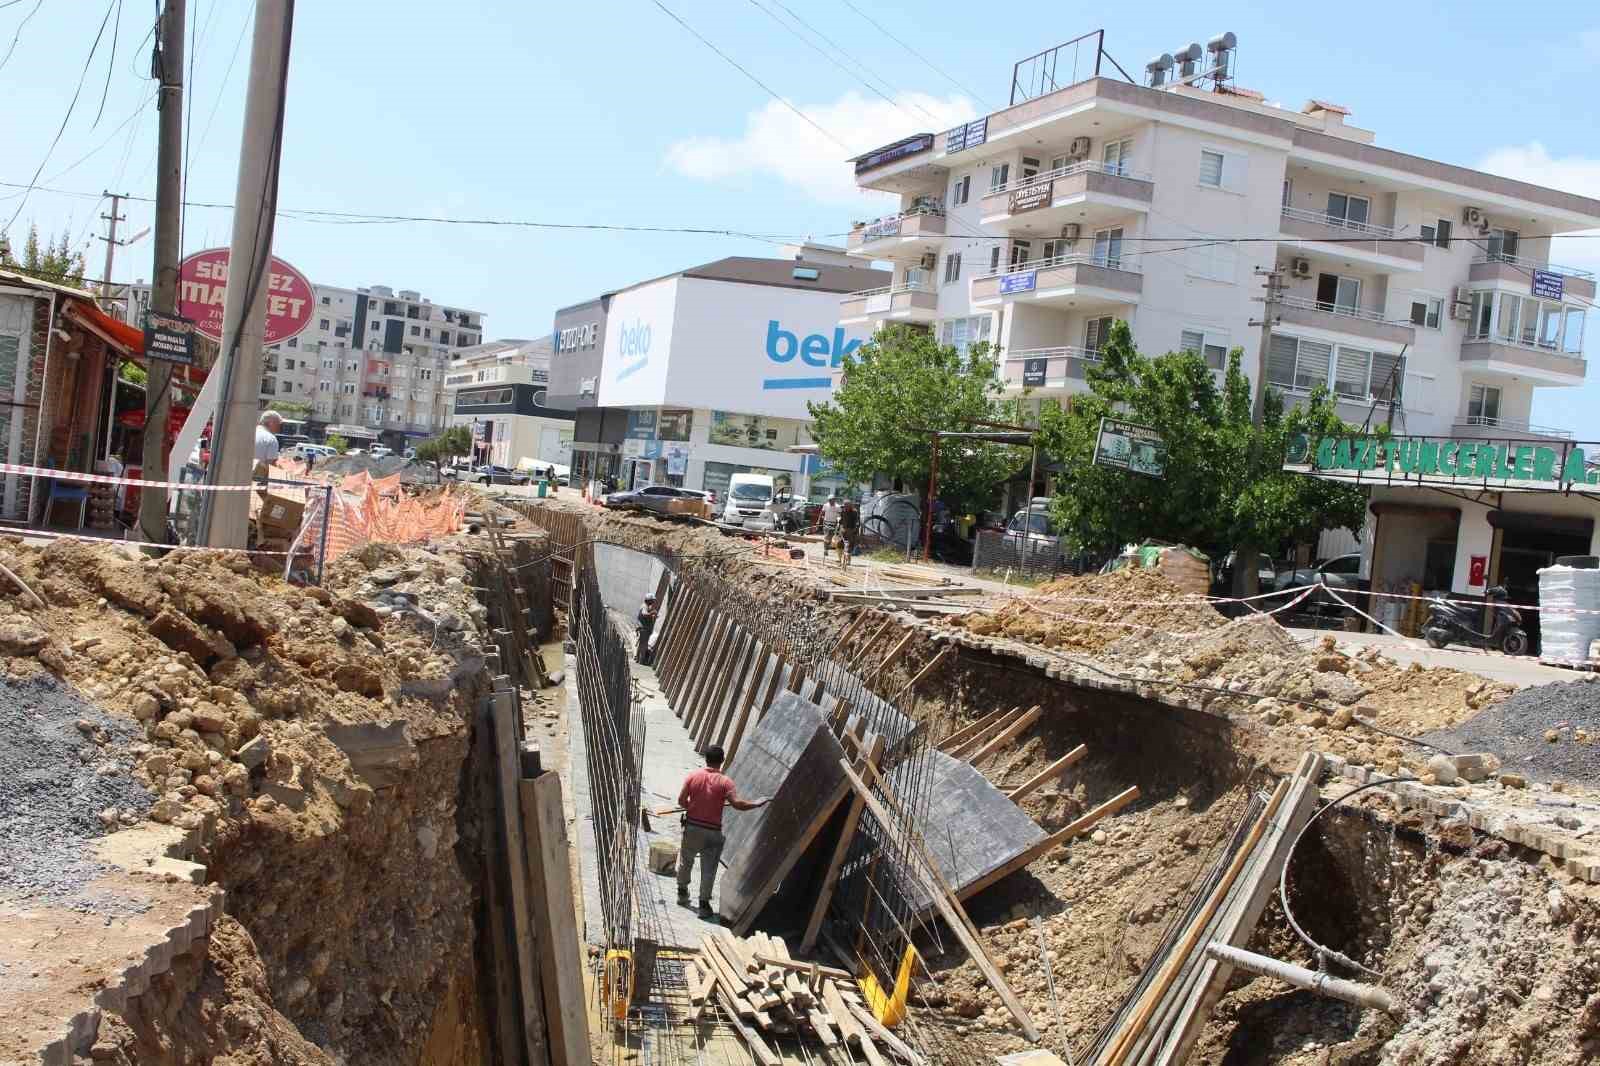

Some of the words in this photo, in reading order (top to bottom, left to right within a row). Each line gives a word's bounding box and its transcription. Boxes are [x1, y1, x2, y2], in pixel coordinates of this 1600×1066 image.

[195, 260, 295, 292] SÖEZ
[181, 279, 306, 320] MAET
[766, 319, 877, 369] bek
